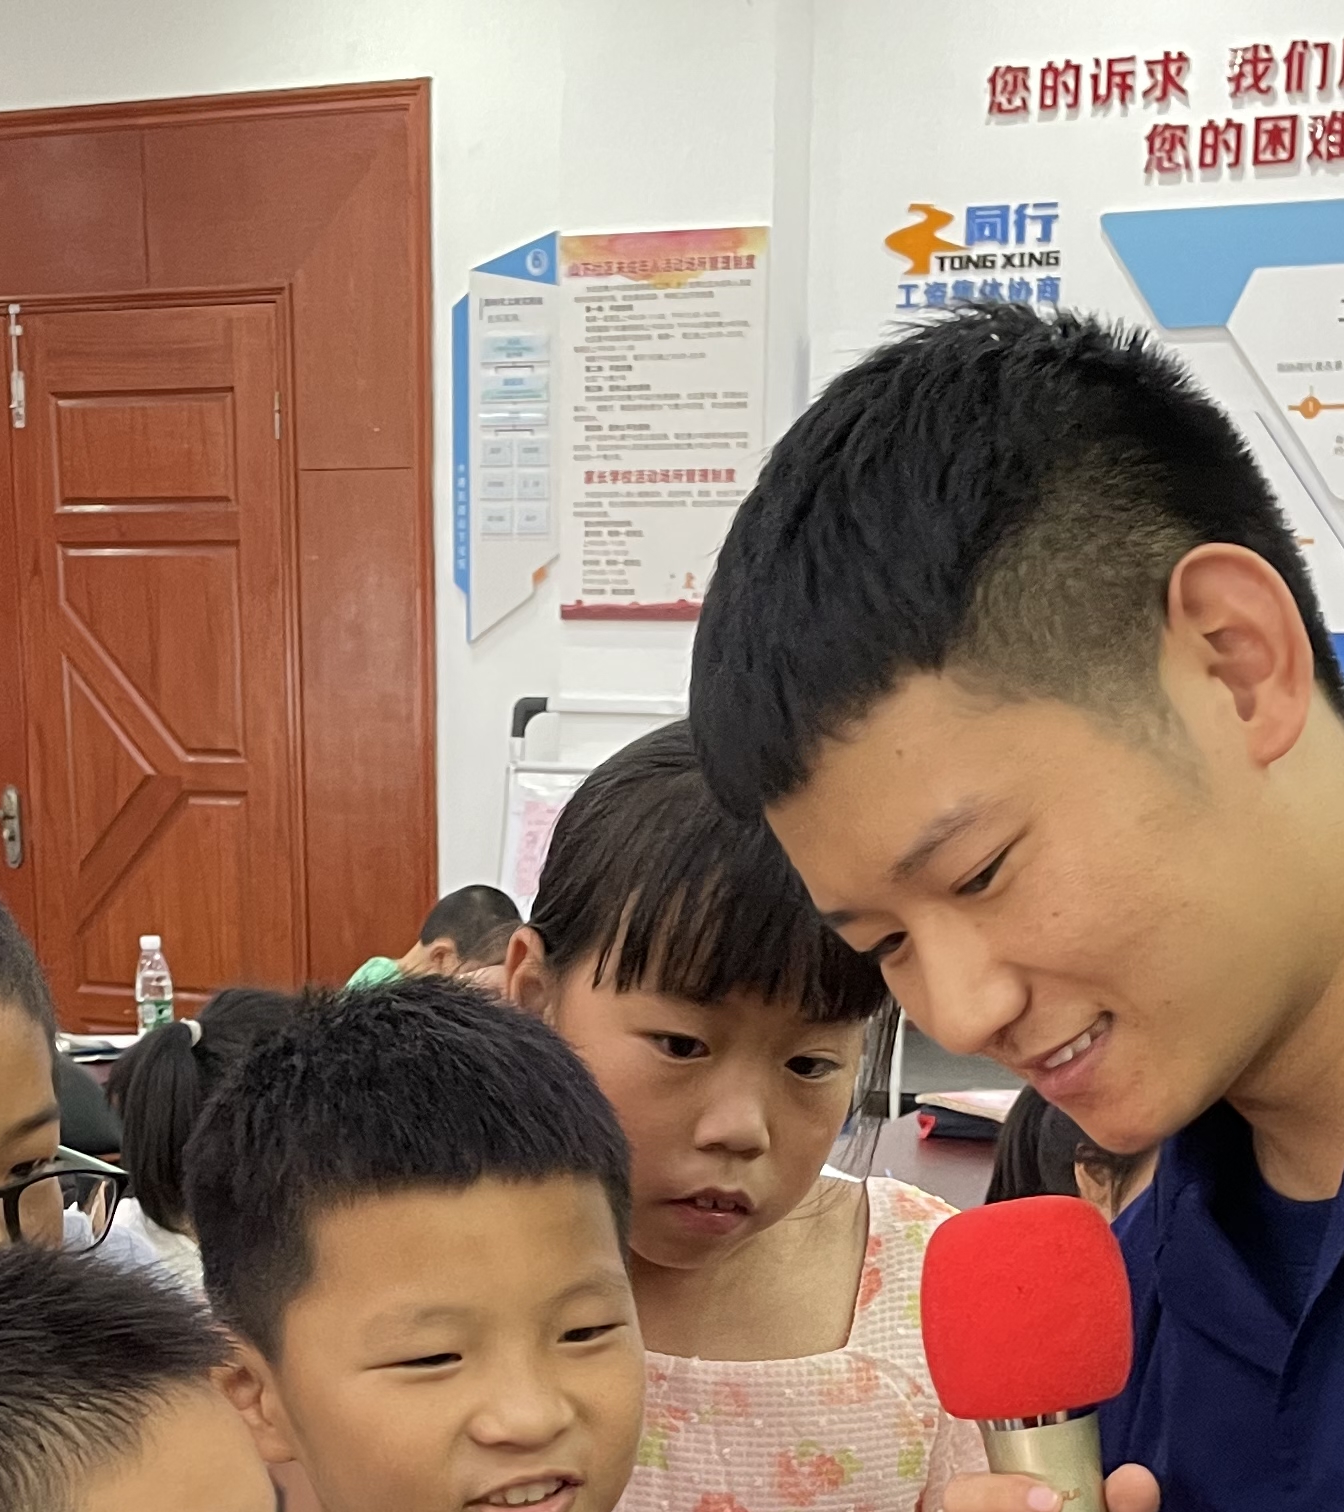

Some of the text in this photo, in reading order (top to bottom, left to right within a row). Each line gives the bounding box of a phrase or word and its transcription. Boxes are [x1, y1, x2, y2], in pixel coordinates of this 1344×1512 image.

[987, 51, 1190, 115] 您的诉求
[965, 202, 1059, 245] 同行
[935, 250, 1060, 271] TONG XING
